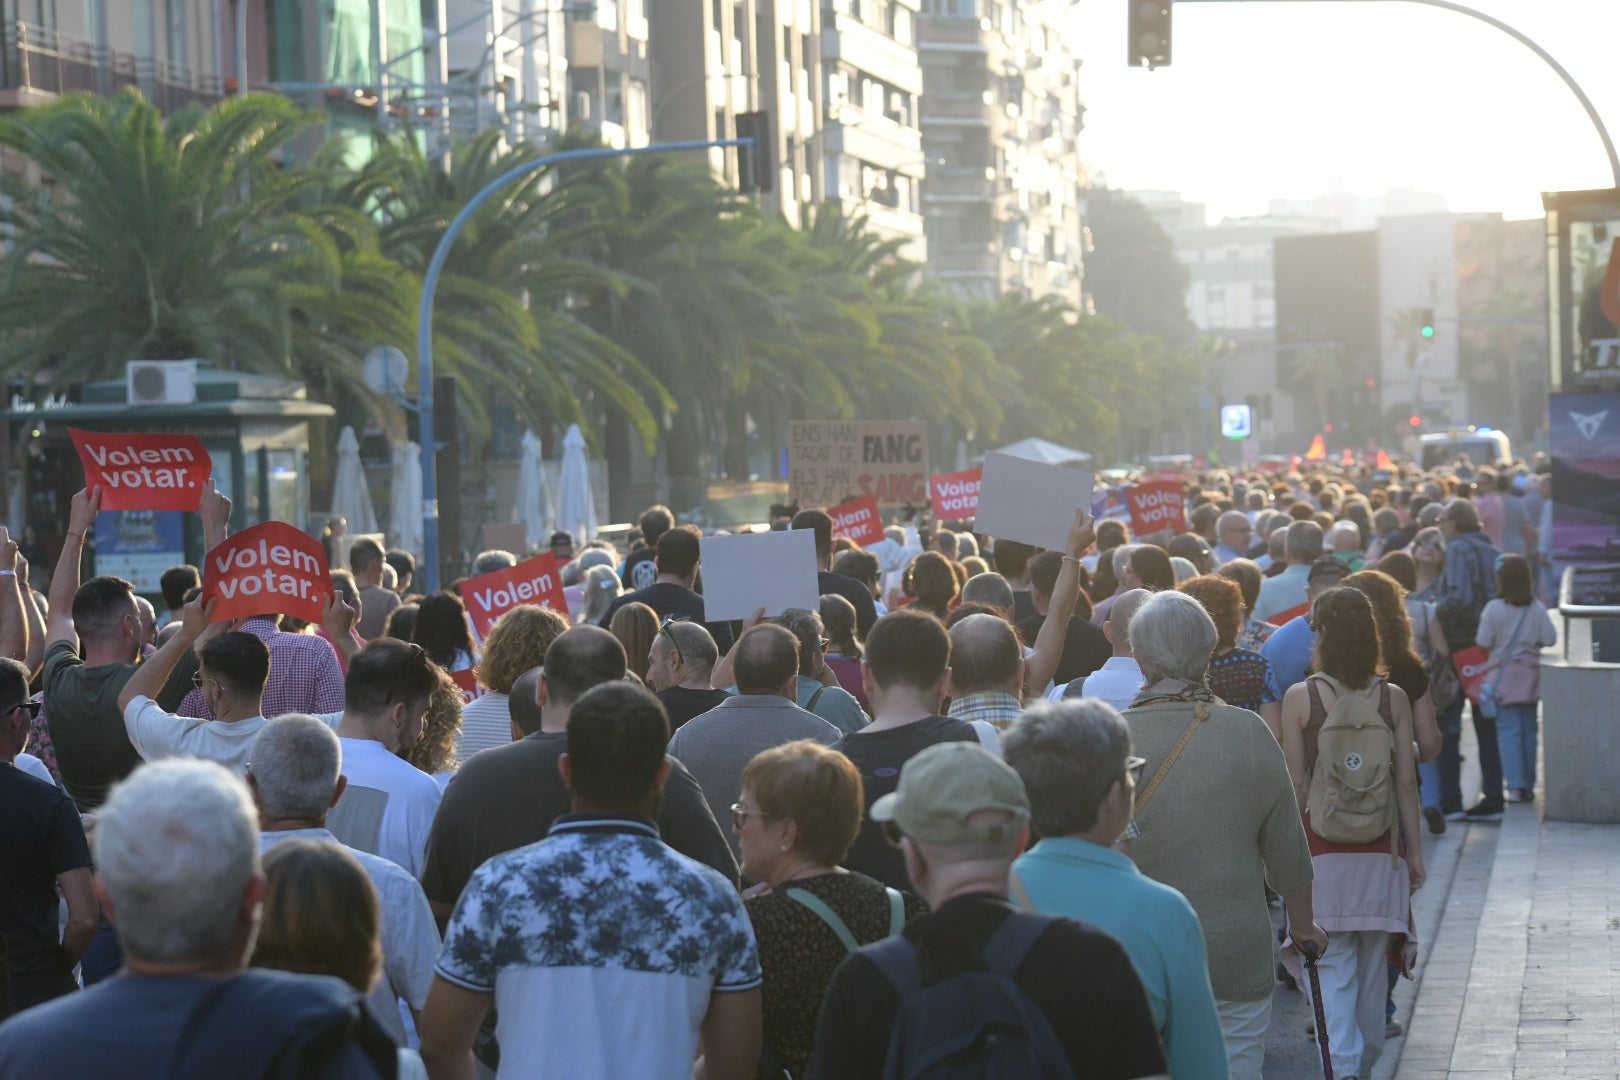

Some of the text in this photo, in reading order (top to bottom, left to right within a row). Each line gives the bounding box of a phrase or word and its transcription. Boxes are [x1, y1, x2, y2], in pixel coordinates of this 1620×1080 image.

[792, 423, 857, 443] ENS HAN
[85, 443, 195, 467] Volem
[839, 445, 858, 463] DE
[863, 434, 922, 463] FANG
[100, 465, 195, 489] votar.
[792, 467, 850, 485] ELS HAN
[857, 472, 925, 503] SANG
[941, 495, 979, 511] vota
[833, 507, 872, 530] olem
[215, 538, 321, 577] Volem
[218, 567, 319, 603] votar.
[473, 573, 553, 612] Volem
